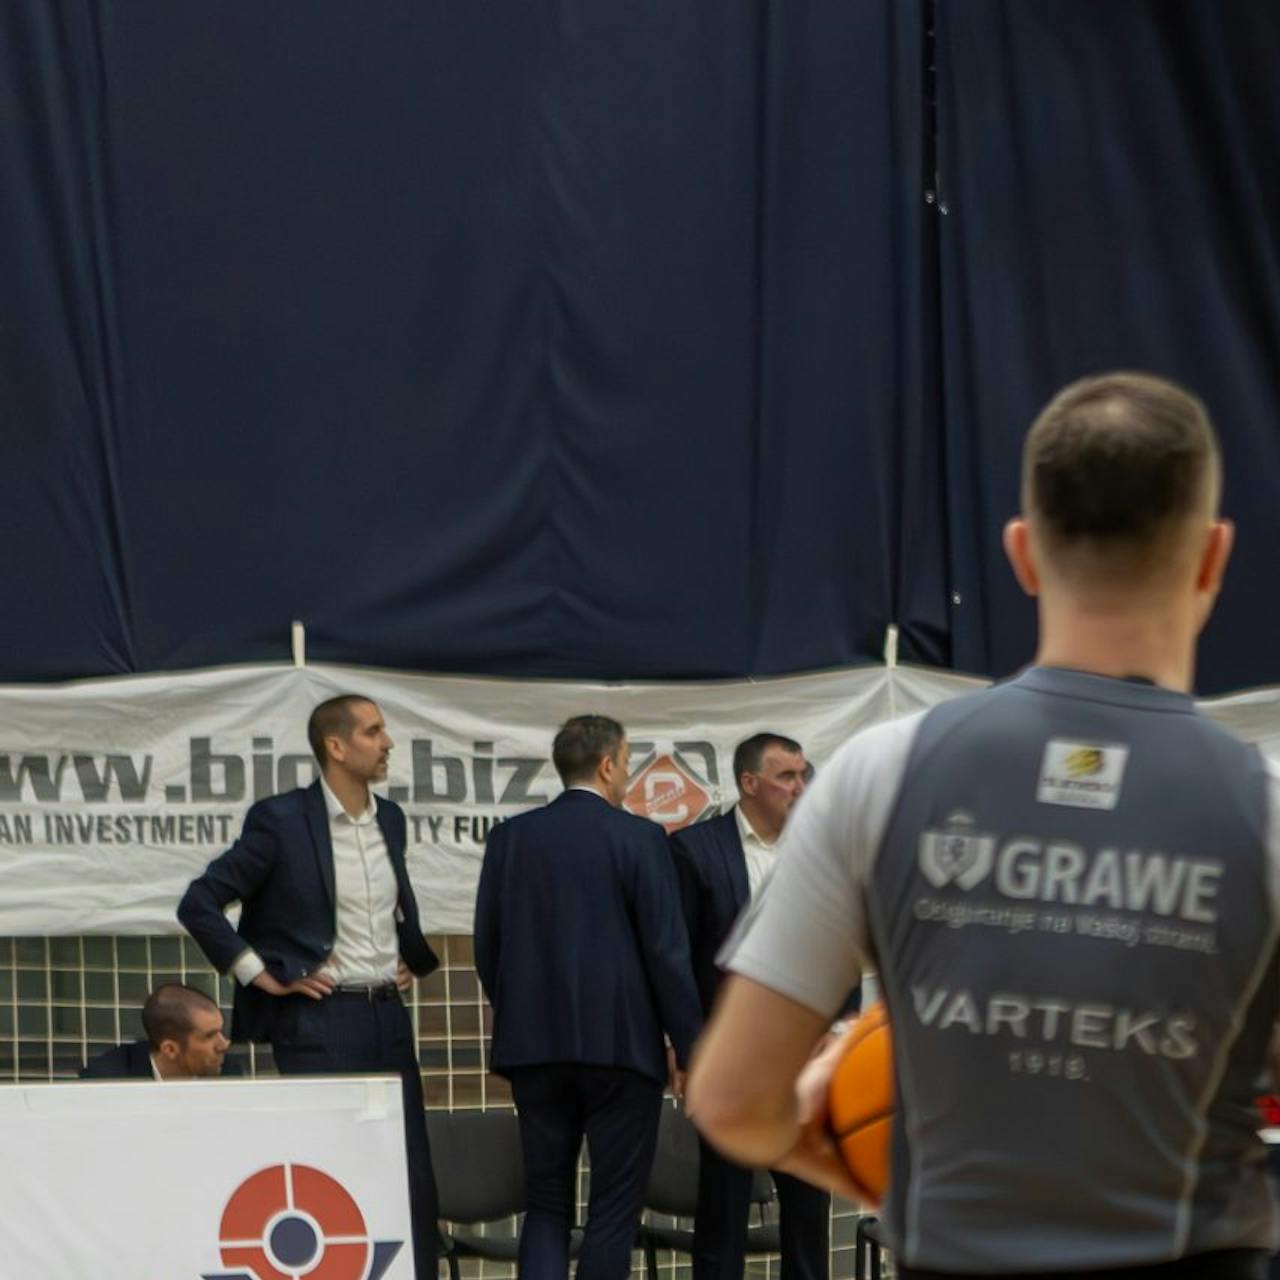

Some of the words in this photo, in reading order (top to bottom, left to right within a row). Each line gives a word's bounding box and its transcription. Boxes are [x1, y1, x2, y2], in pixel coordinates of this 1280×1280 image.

[45, 813, 233, 847] INVESTMENT
[998, 836, 1226, 923] GRAWE
[911, 984, 1199, 1061] VARTEKS
